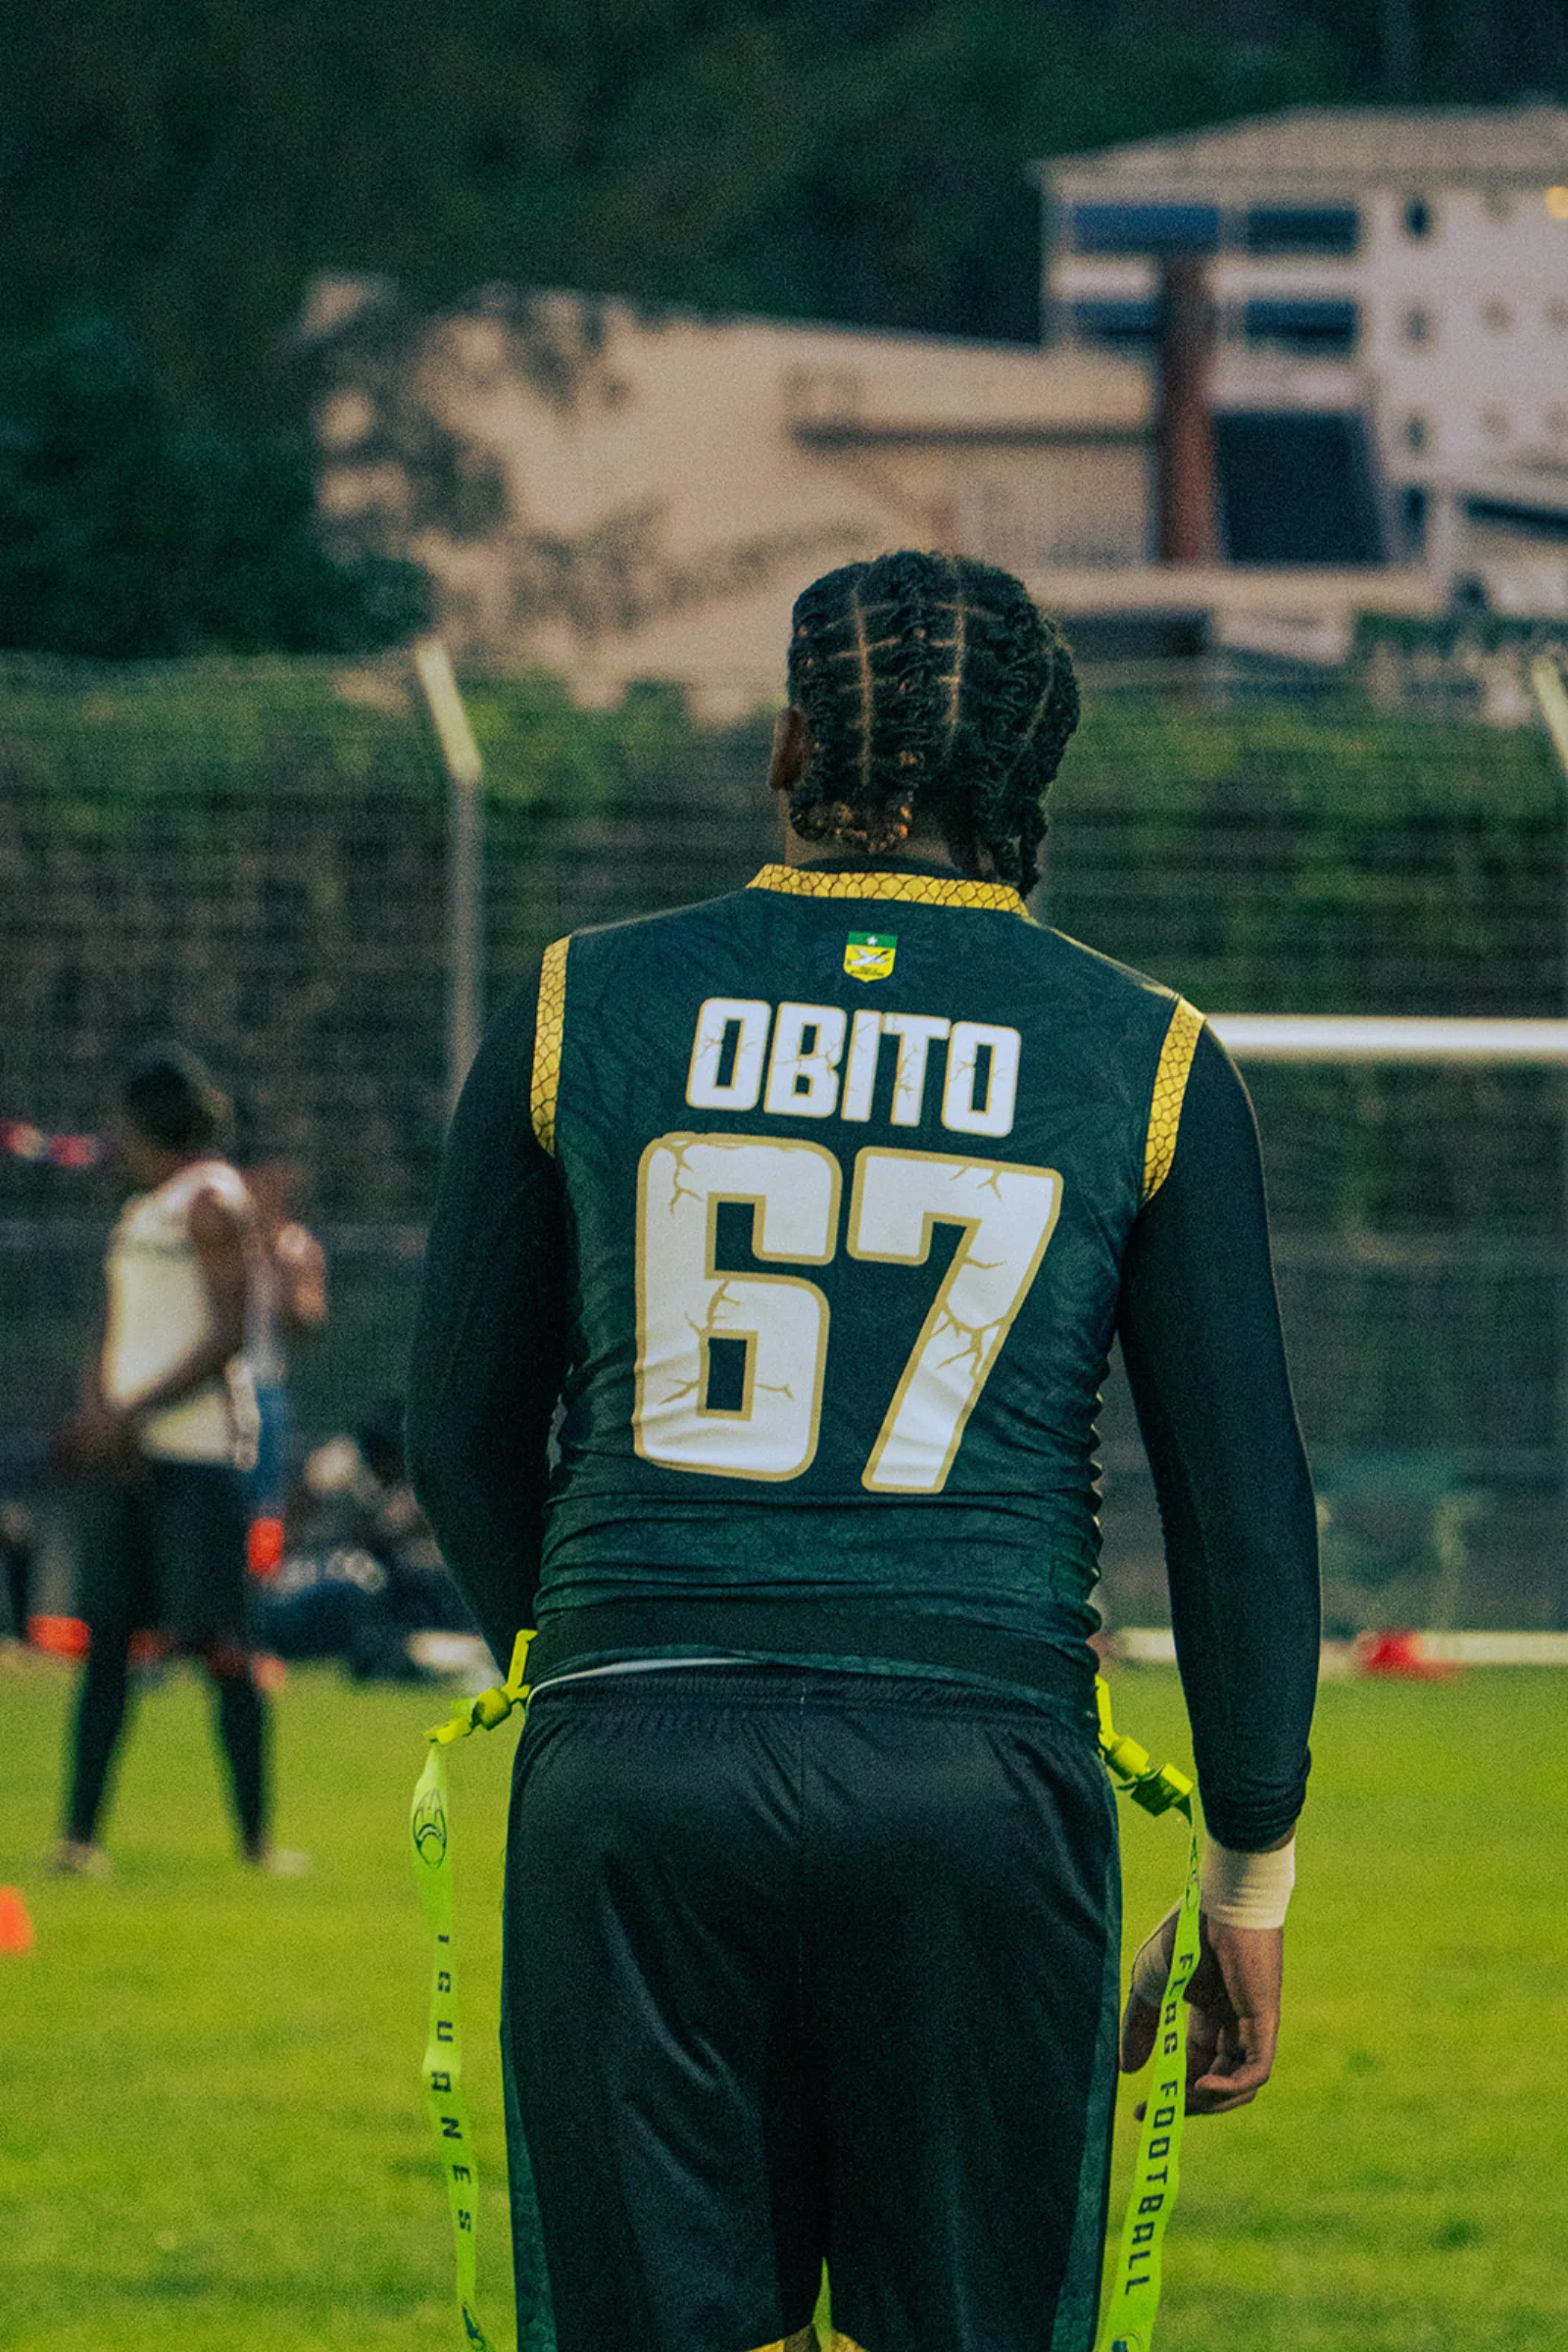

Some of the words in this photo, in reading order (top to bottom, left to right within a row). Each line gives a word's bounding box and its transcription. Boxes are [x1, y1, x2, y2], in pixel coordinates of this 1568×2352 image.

[686, 998, 1021, 1137] OBITO
[634, 1131, 1063, 1494] 67
[1163, 1952, 1194, 2055] FLAG
[1124, 2079, 1178, 2296] FOOTBALL
